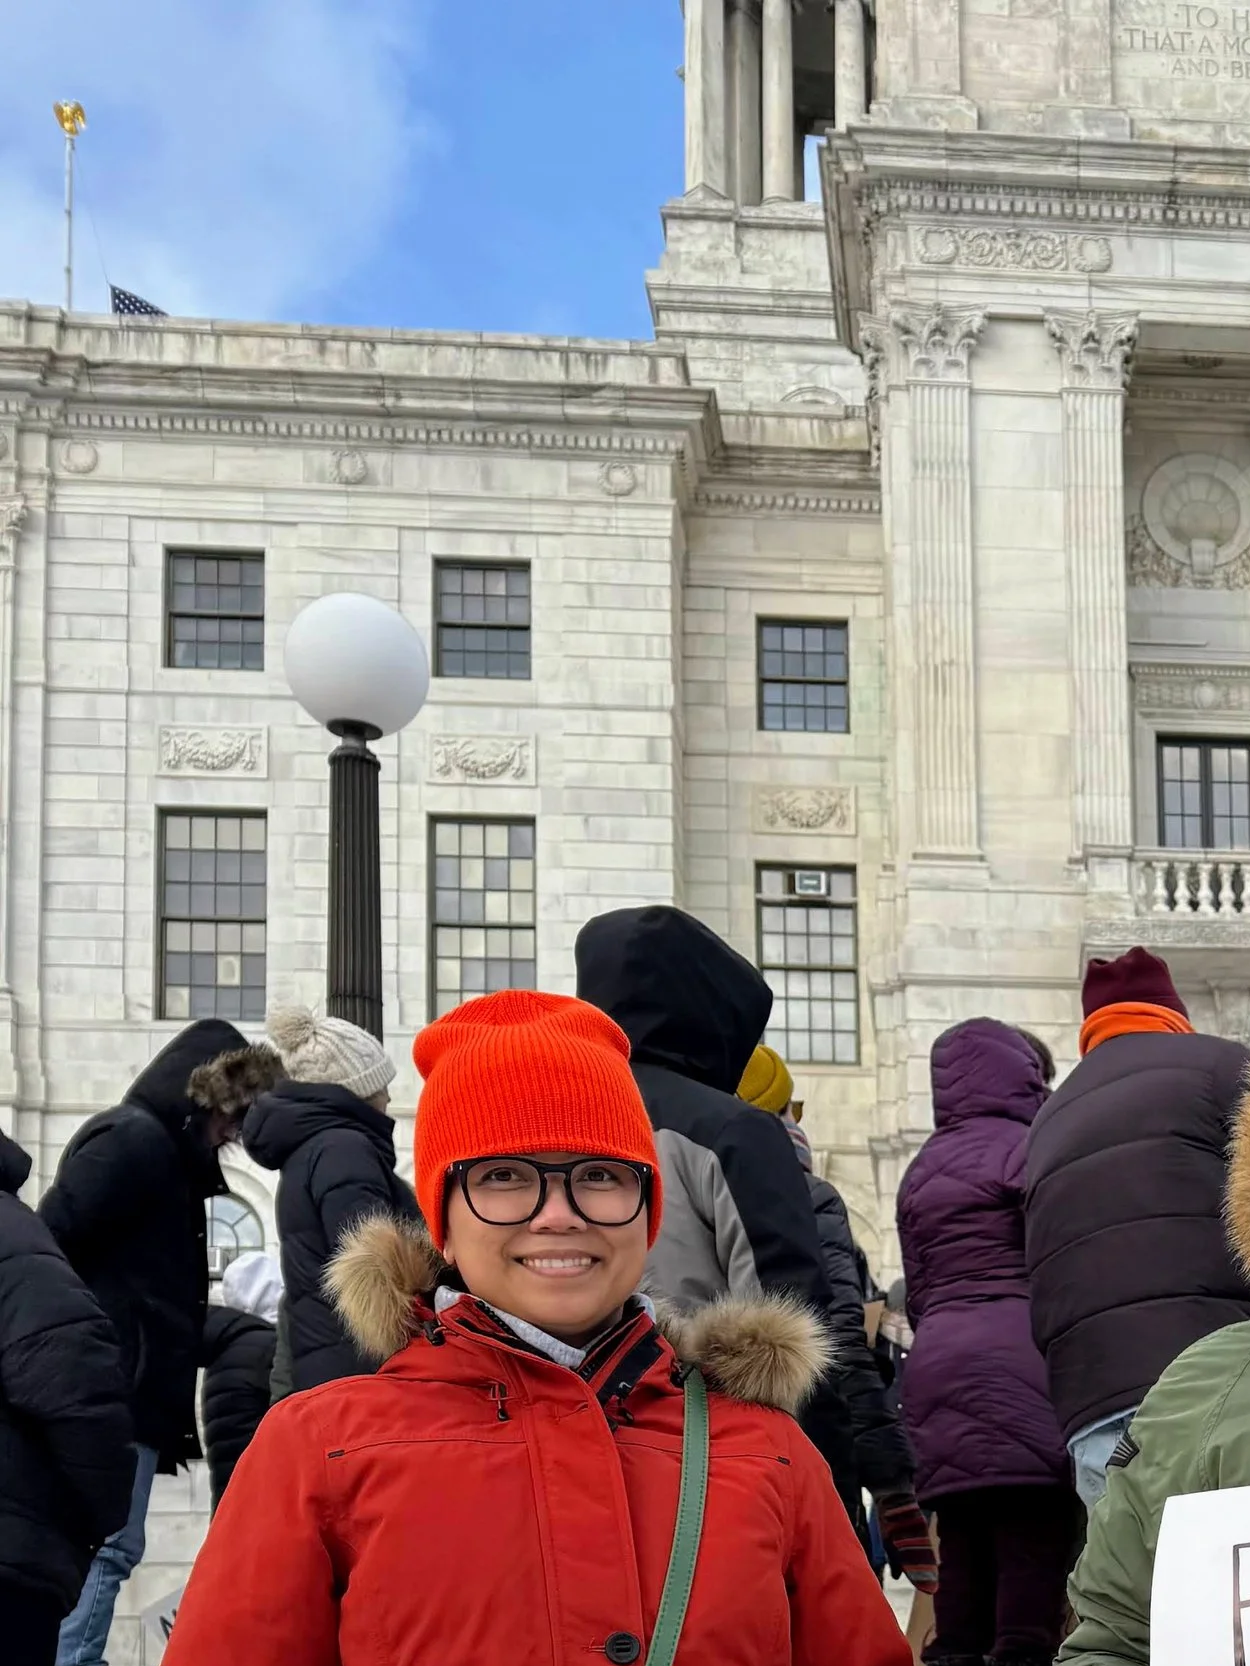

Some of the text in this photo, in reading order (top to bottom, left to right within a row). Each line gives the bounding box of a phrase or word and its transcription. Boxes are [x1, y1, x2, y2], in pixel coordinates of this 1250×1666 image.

[1177, 4, 1219, 29] TO
[1124, 28, 1192, 53] THAT
[1199, 35, 1214, 54] A
[1172, 58, 1219, 77] AND
